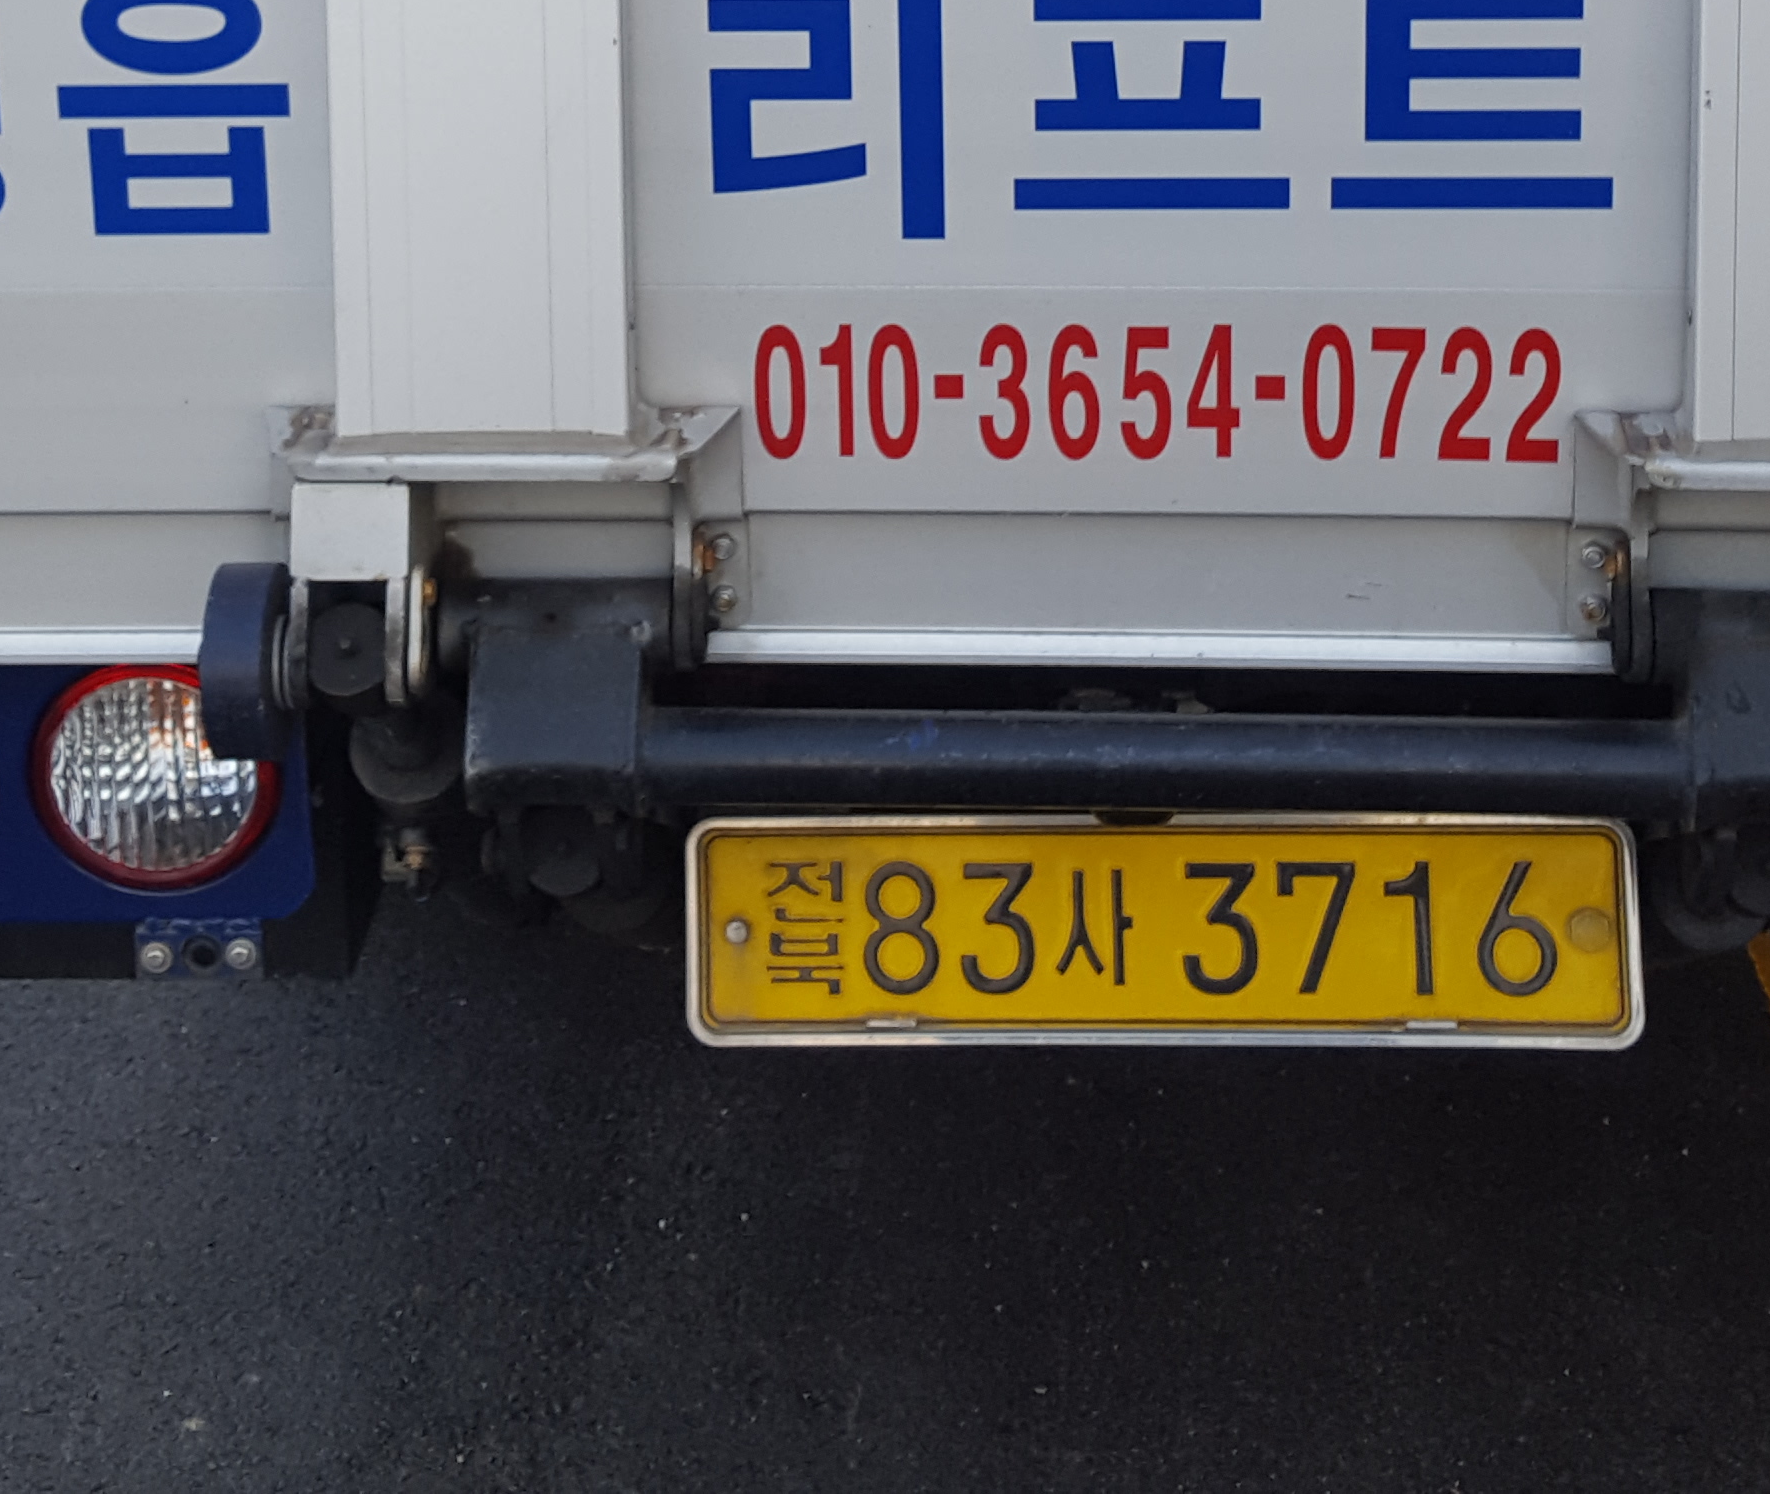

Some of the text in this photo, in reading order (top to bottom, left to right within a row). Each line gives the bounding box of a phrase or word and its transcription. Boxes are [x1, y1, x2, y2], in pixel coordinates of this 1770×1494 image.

[754, 322, 1563, 464] 010-3654-0722
[766, 860, 1559, 998] 전북 83사 3716
